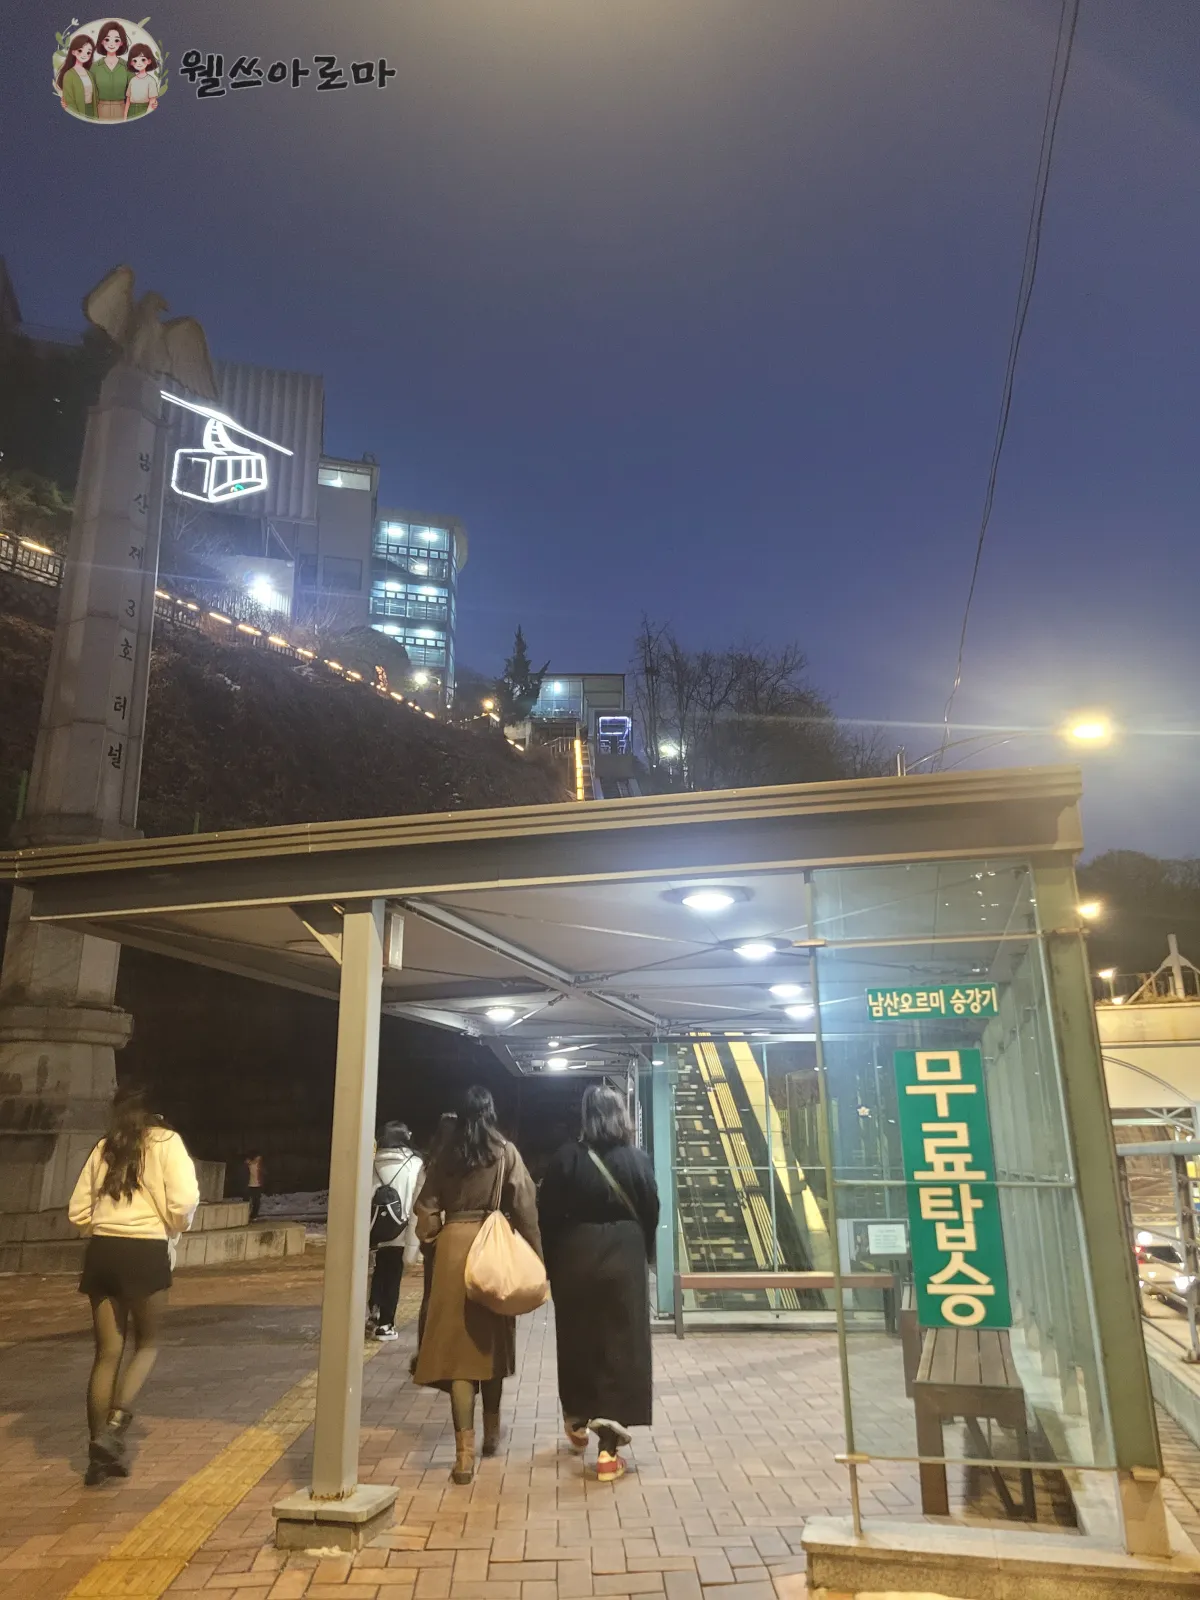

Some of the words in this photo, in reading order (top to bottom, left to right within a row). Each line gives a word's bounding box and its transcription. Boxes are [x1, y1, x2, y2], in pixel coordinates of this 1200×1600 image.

[868, 988, 946, 1017] 남산오르미
[949, 987, 998, 1014] 승강기
[905, 1050, 996, 1327] 무료탑승
